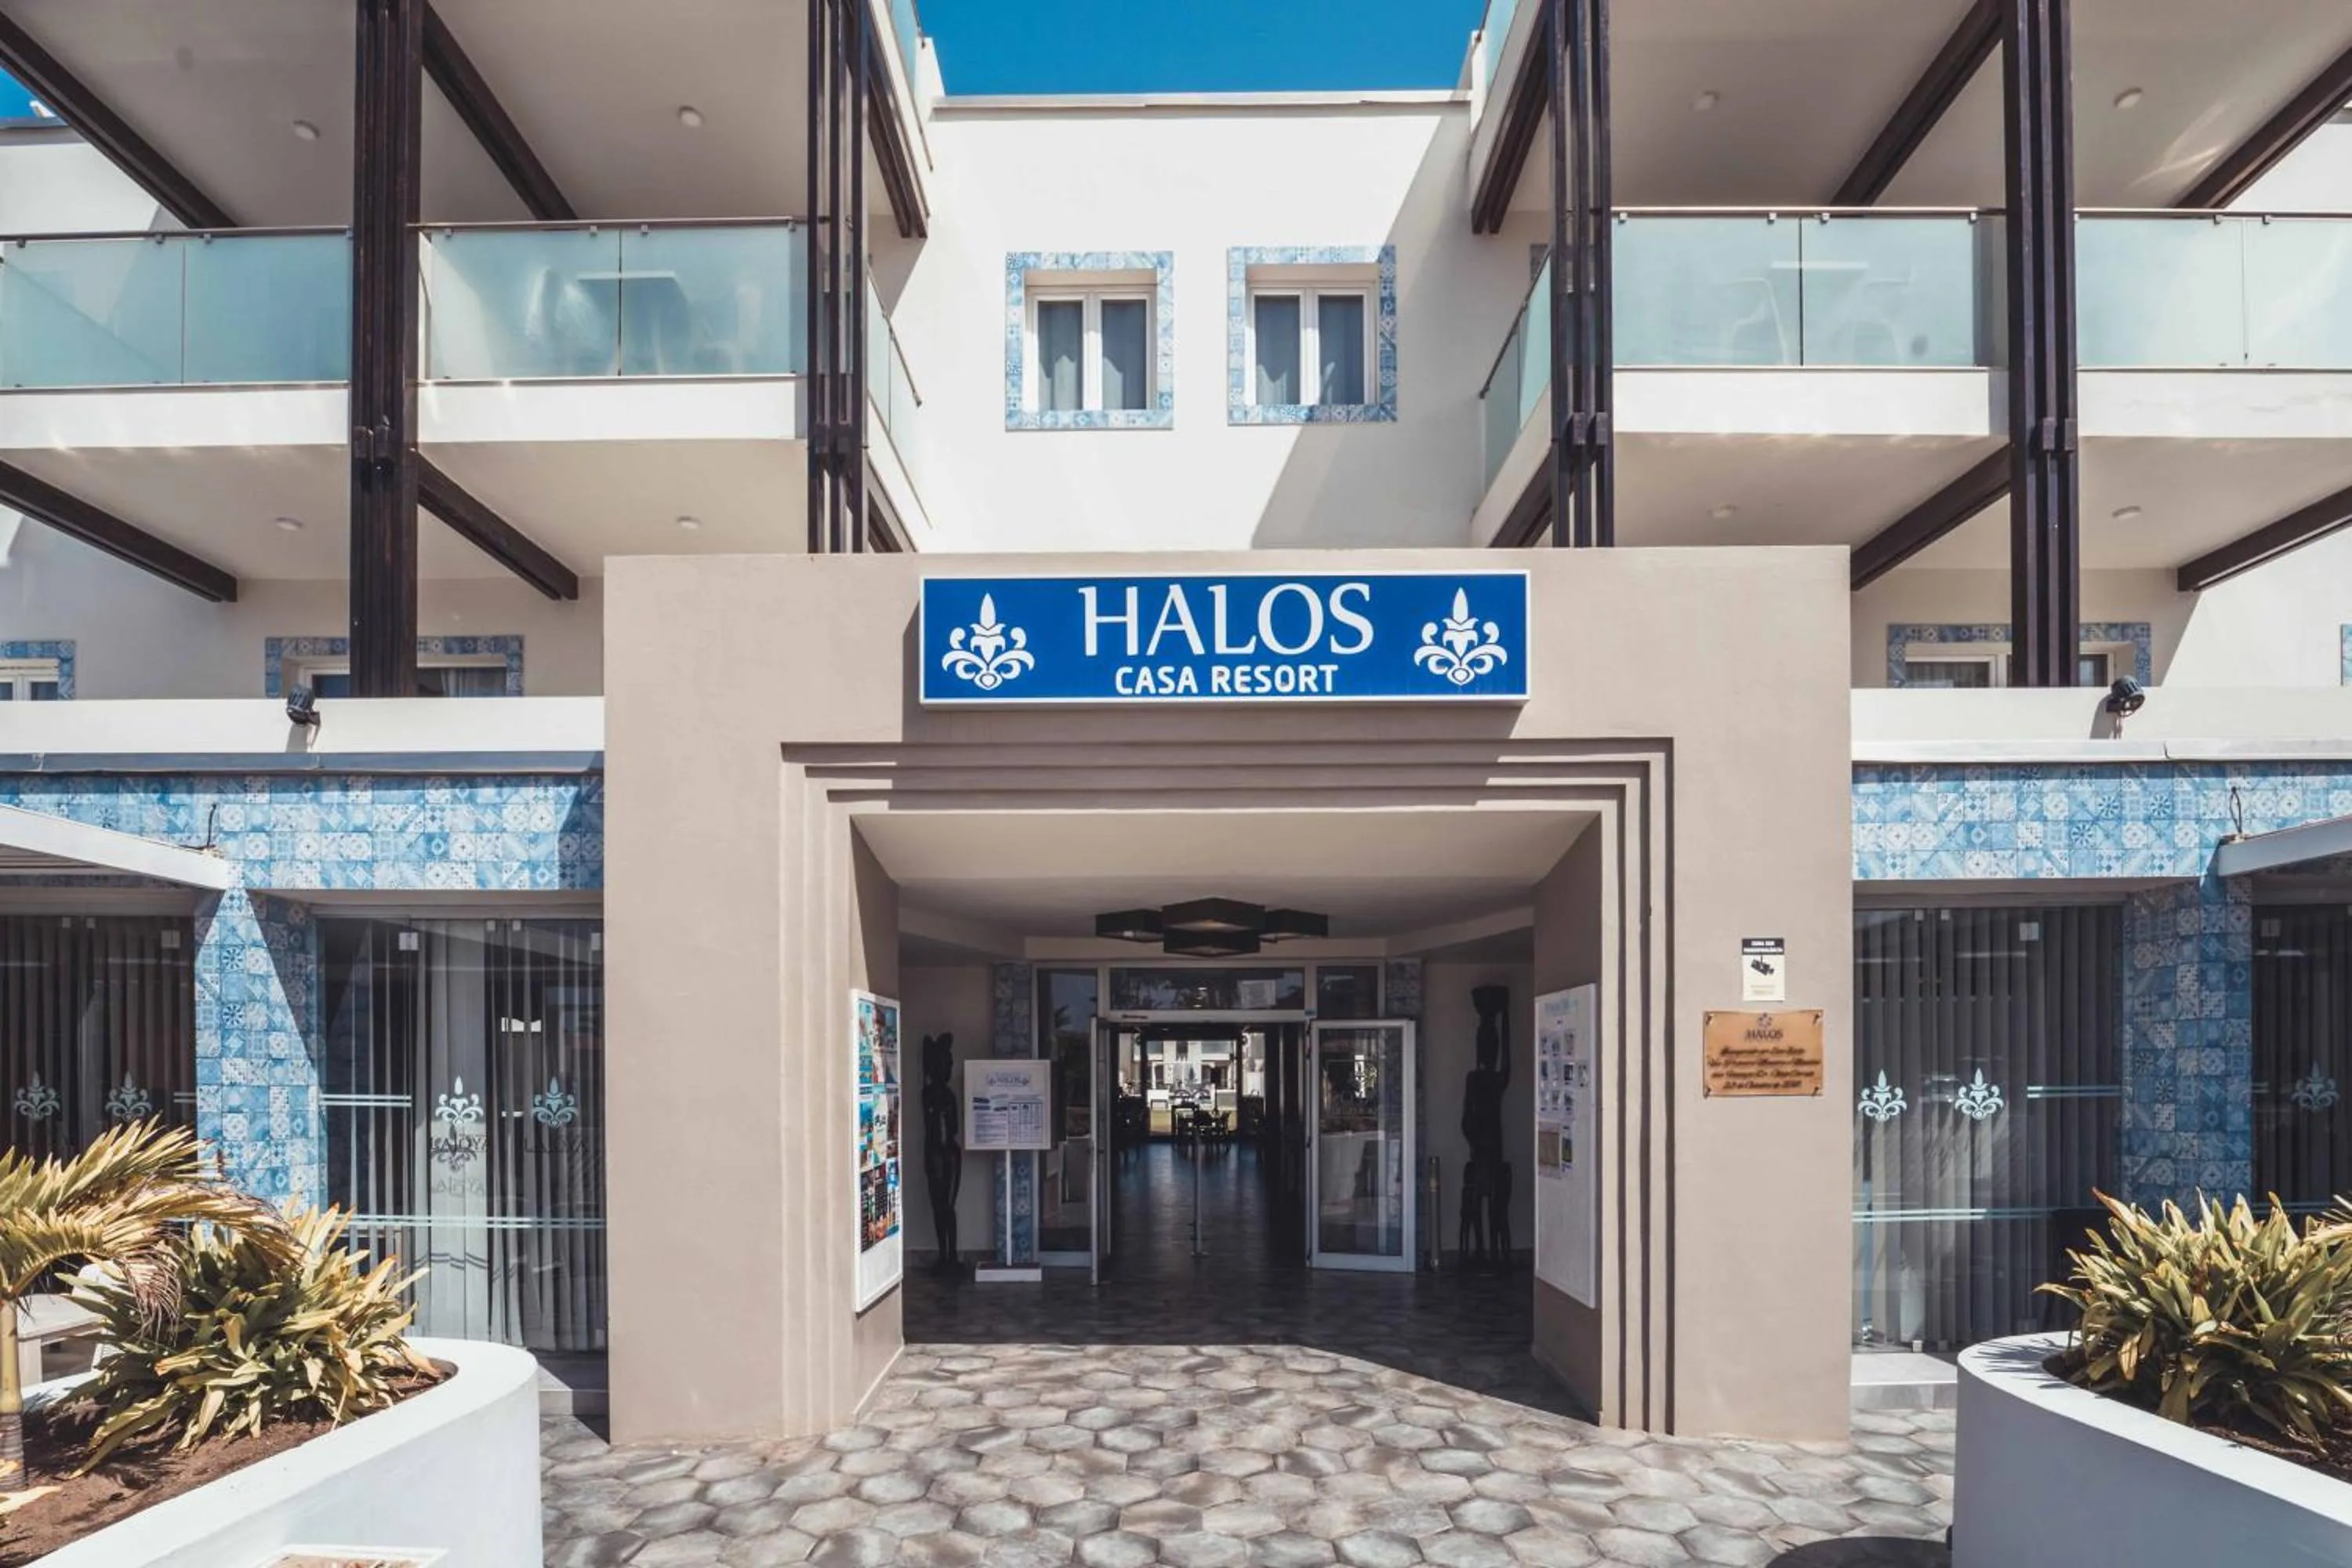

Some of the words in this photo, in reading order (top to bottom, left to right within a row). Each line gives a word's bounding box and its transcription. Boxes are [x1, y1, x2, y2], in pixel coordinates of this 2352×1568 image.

[1078, 583, 1374, 656] HALOS
[1116, 666, 1198, 695] CASA
[1211, 664, 1339, 694] RESORT
